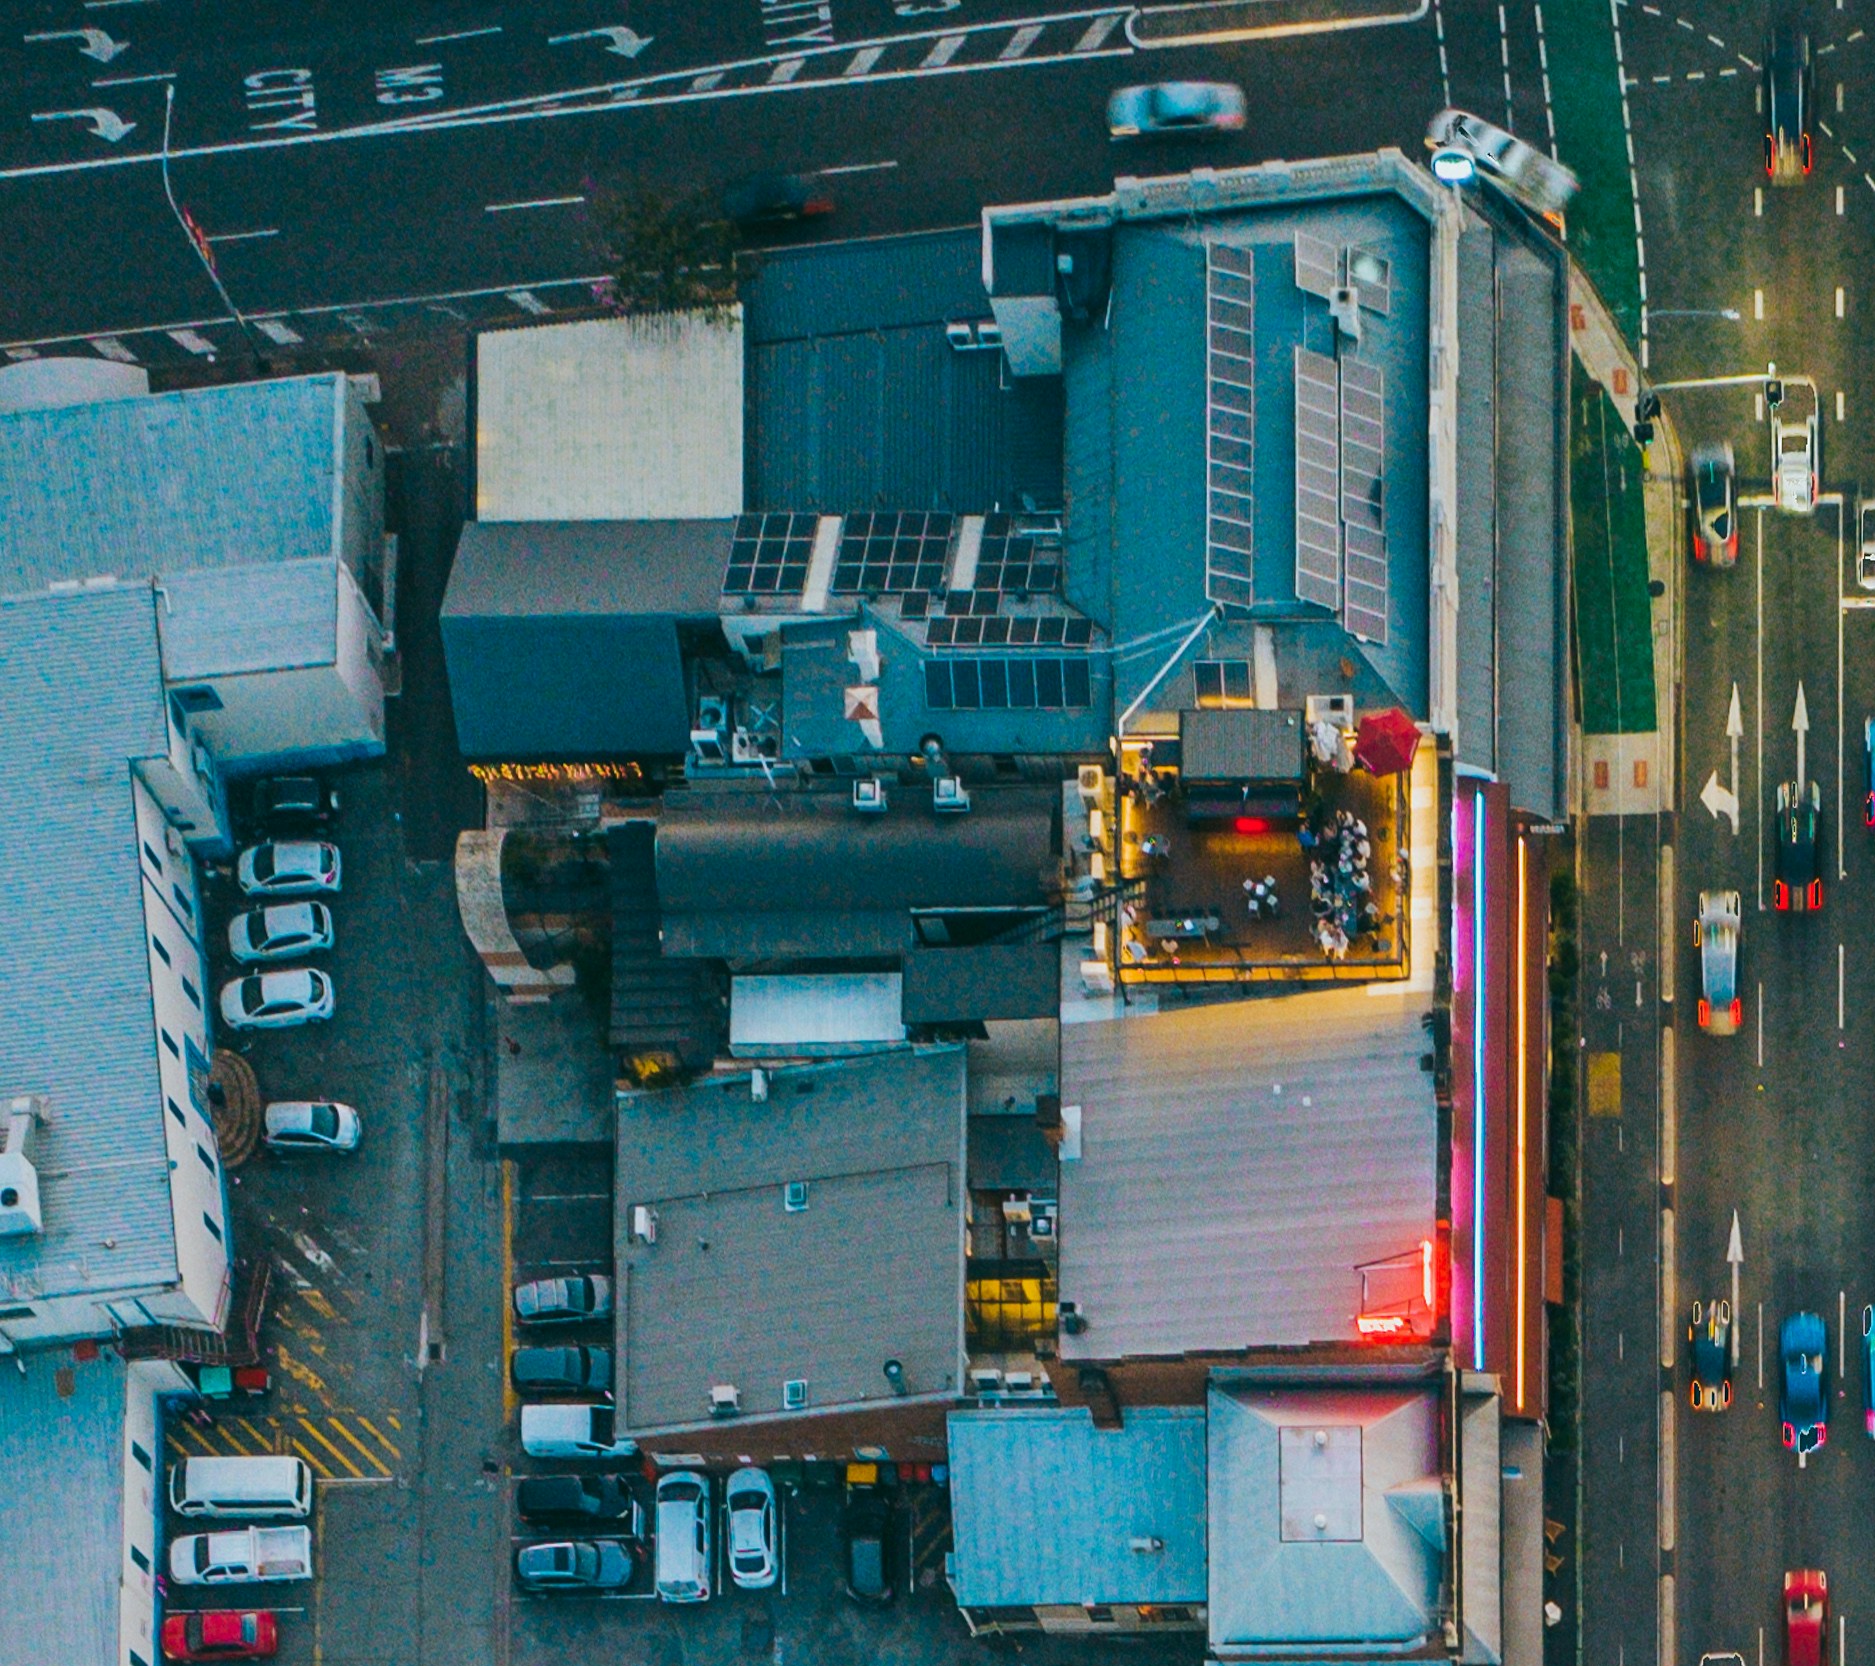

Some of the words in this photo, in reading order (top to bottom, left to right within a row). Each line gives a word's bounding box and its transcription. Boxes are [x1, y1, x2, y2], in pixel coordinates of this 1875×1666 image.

[760, 0, 834, 45] ITY
[244, 68, 318, 130] CITY
[375, 63, 444, 104] M3
